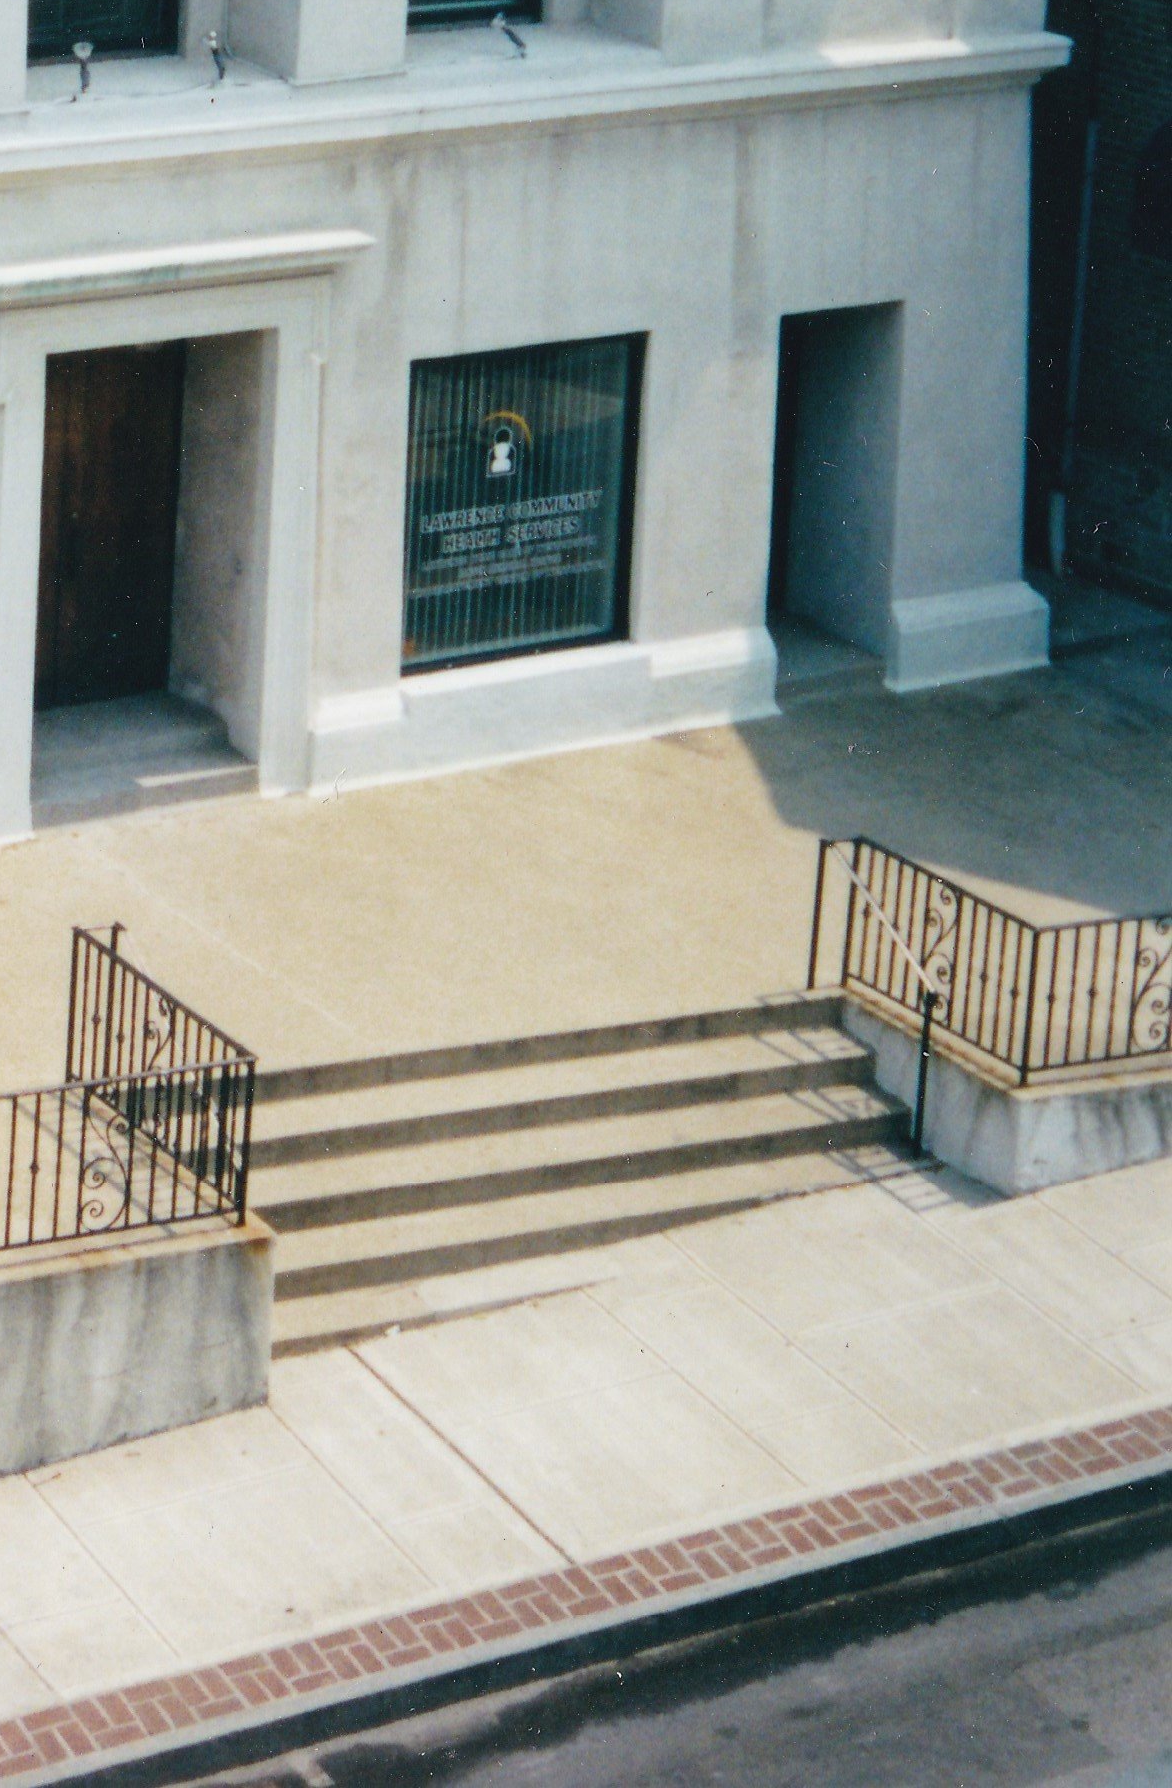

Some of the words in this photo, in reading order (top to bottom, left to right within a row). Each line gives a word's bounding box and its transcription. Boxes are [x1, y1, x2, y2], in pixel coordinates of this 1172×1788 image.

[421, 505, 505, 532] LAWRENCE
[508, 490, 603, 519] COMMUNITY
[443, 527, 500, 552] HEALTH
[506, 517, 579, 543] SERVICES
